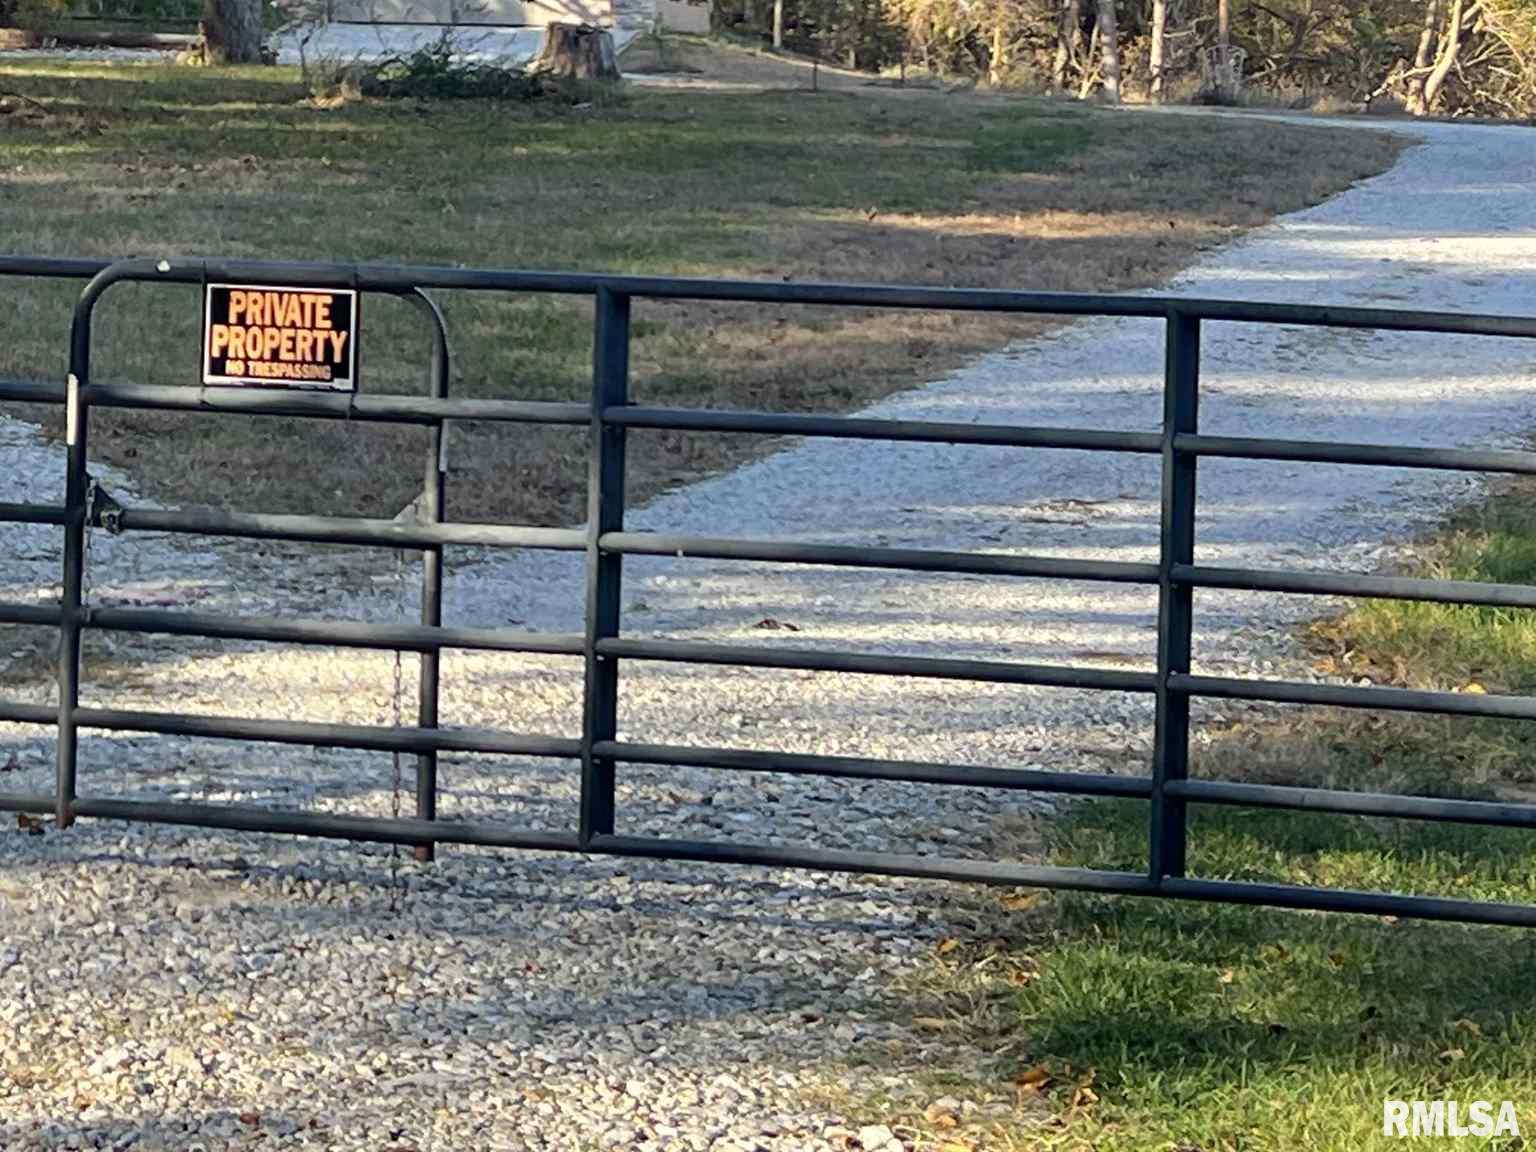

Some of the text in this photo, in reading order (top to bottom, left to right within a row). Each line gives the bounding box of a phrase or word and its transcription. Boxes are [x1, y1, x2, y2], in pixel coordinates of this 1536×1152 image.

[229, 291, 332, 328] PRIVATE
[212, 324, 347, 363] PROPERTY
[225, 359, 331, 380] NO TRESPASSING
